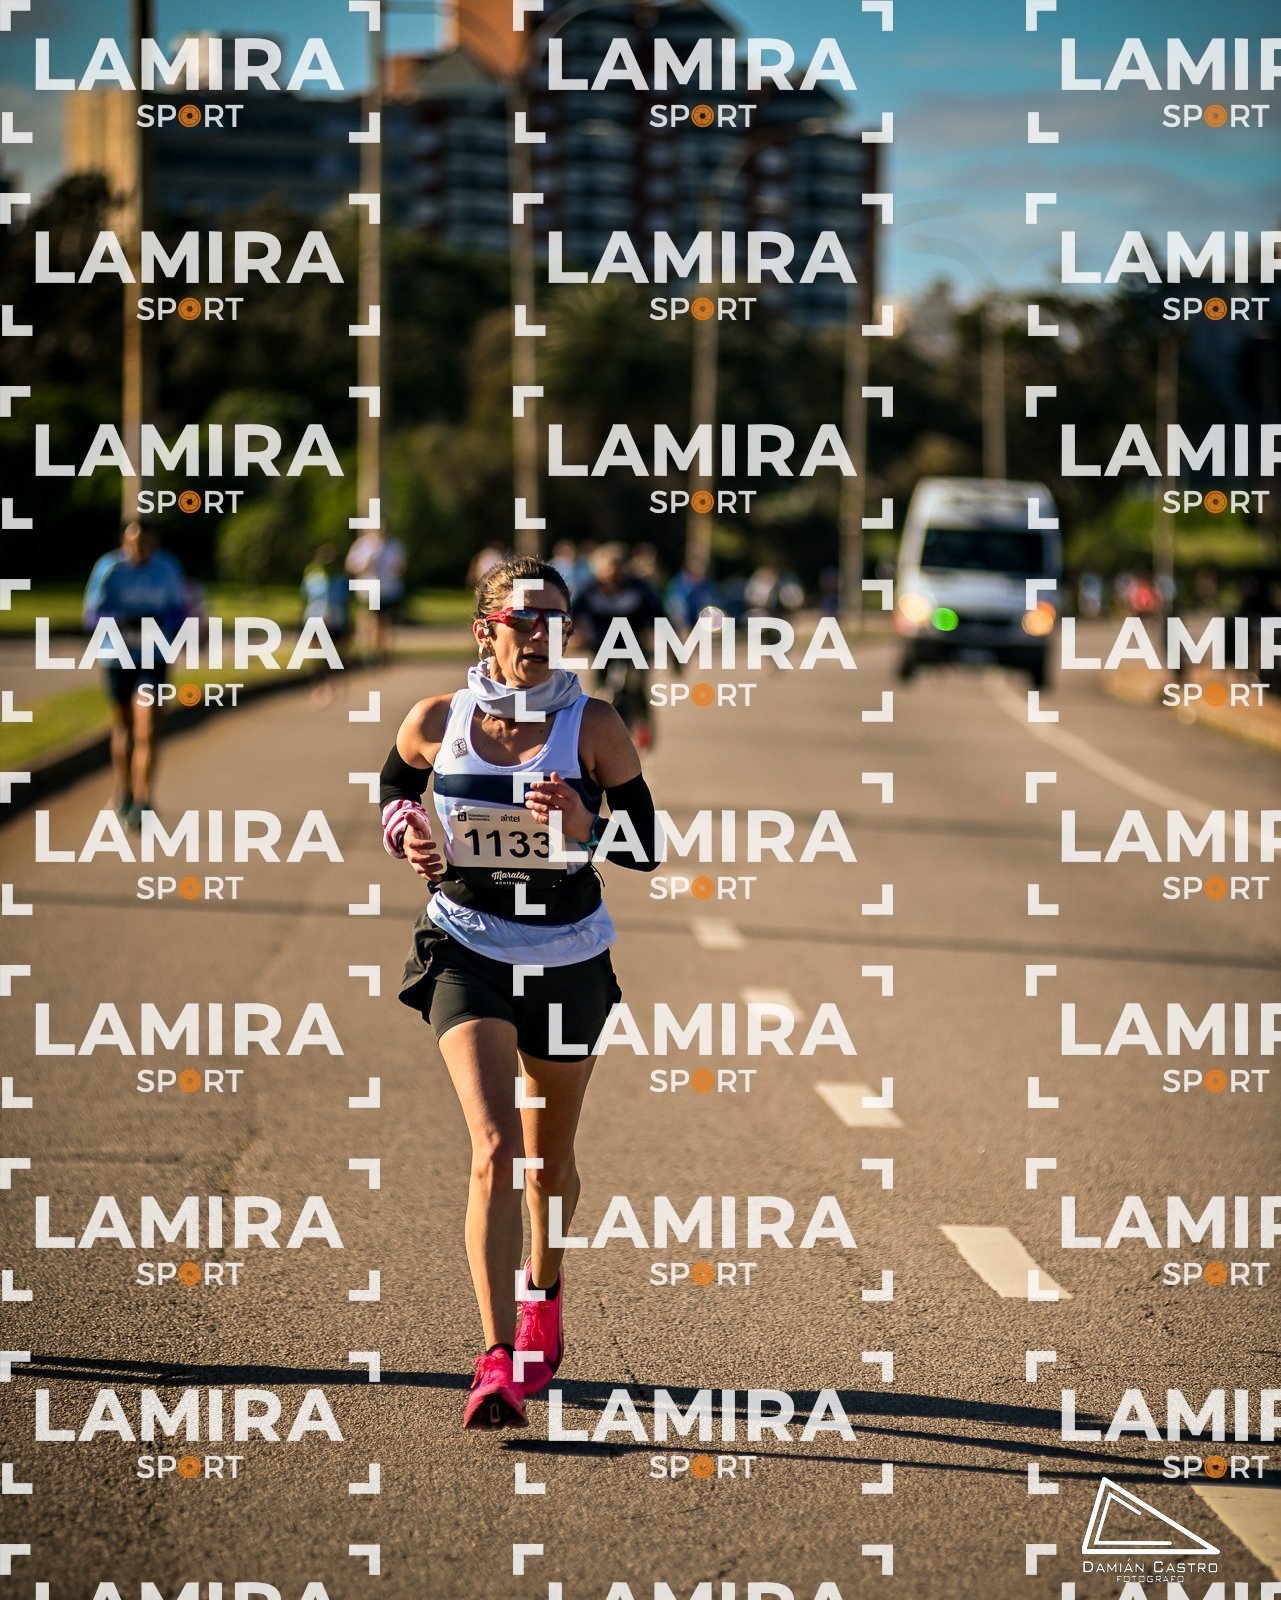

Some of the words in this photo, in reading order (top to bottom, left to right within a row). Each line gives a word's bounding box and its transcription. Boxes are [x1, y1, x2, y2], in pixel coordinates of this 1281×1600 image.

[500, 814, 520, 823] antel
[464, 829, 554, 858] 1133
[491, 870, 531, 882] Maratón
